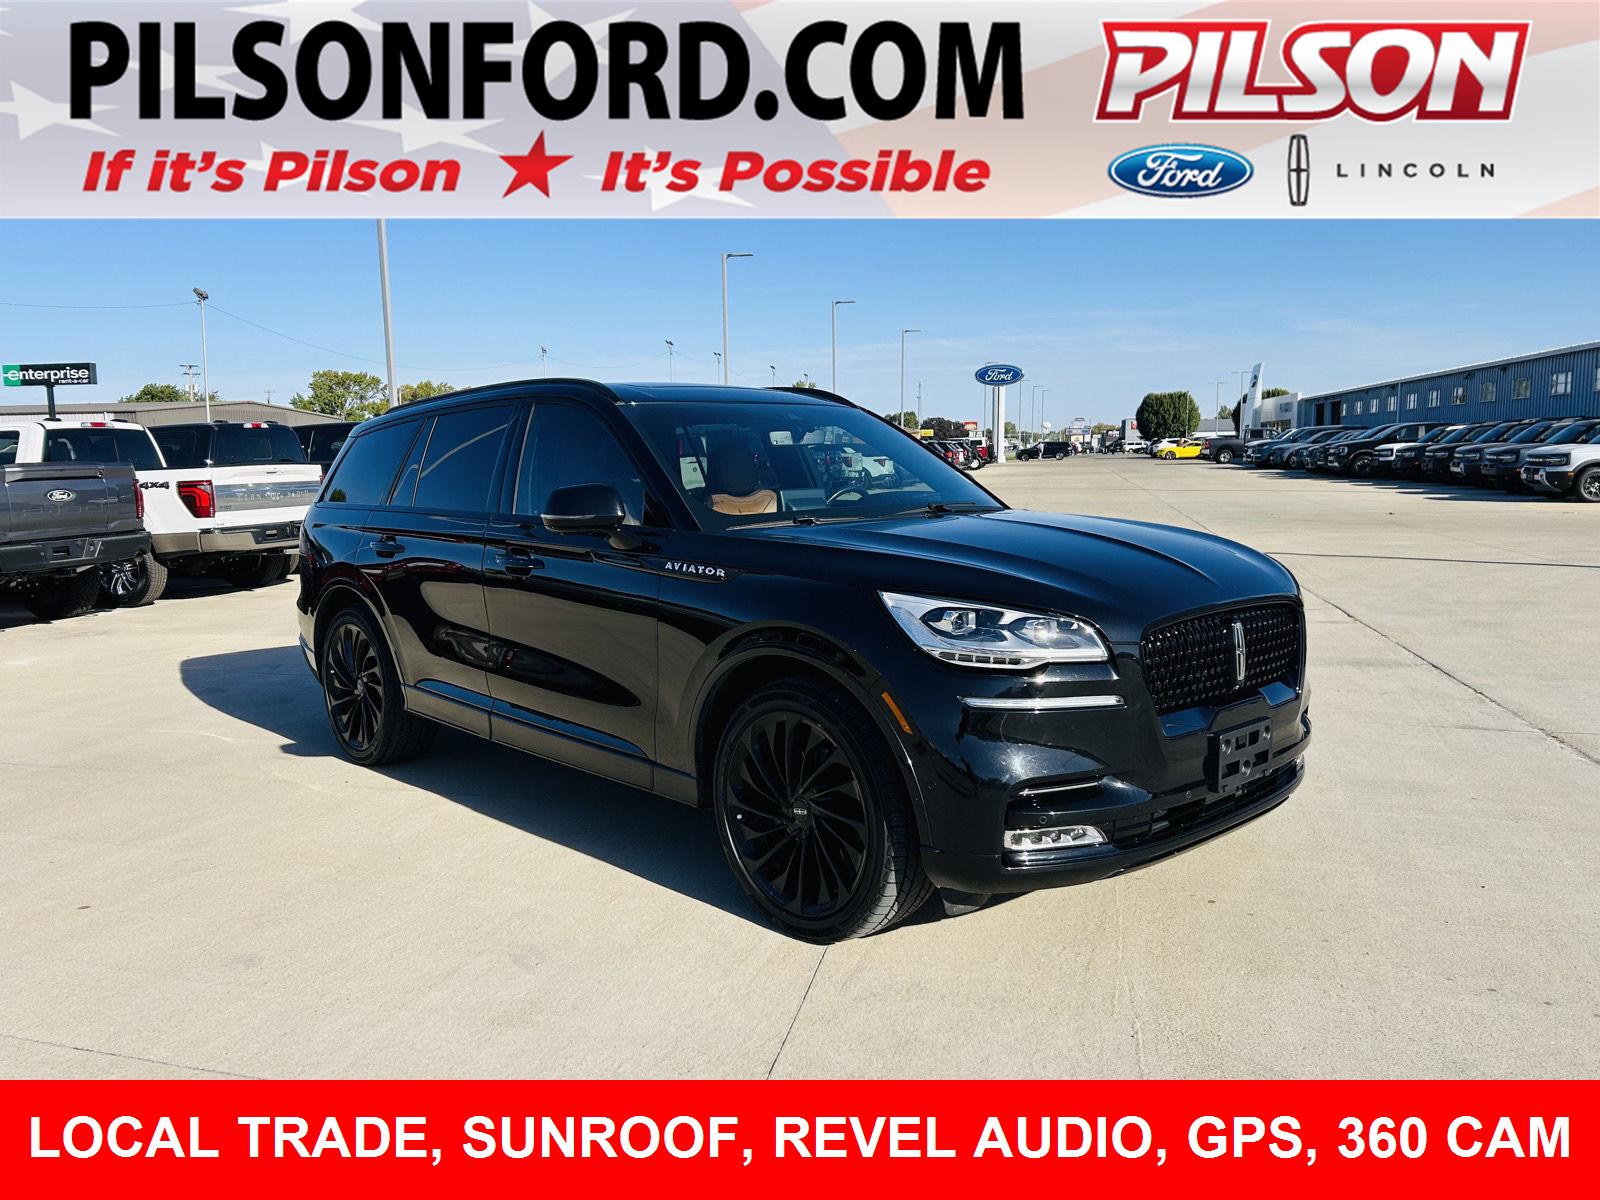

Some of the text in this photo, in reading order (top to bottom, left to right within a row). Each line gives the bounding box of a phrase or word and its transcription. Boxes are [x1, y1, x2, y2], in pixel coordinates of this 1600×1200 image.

[7, 367, 89, 382] enterprise
[985, 368, 1014, 381] Ford
[665, 561, 725, 577] AVIATOR
